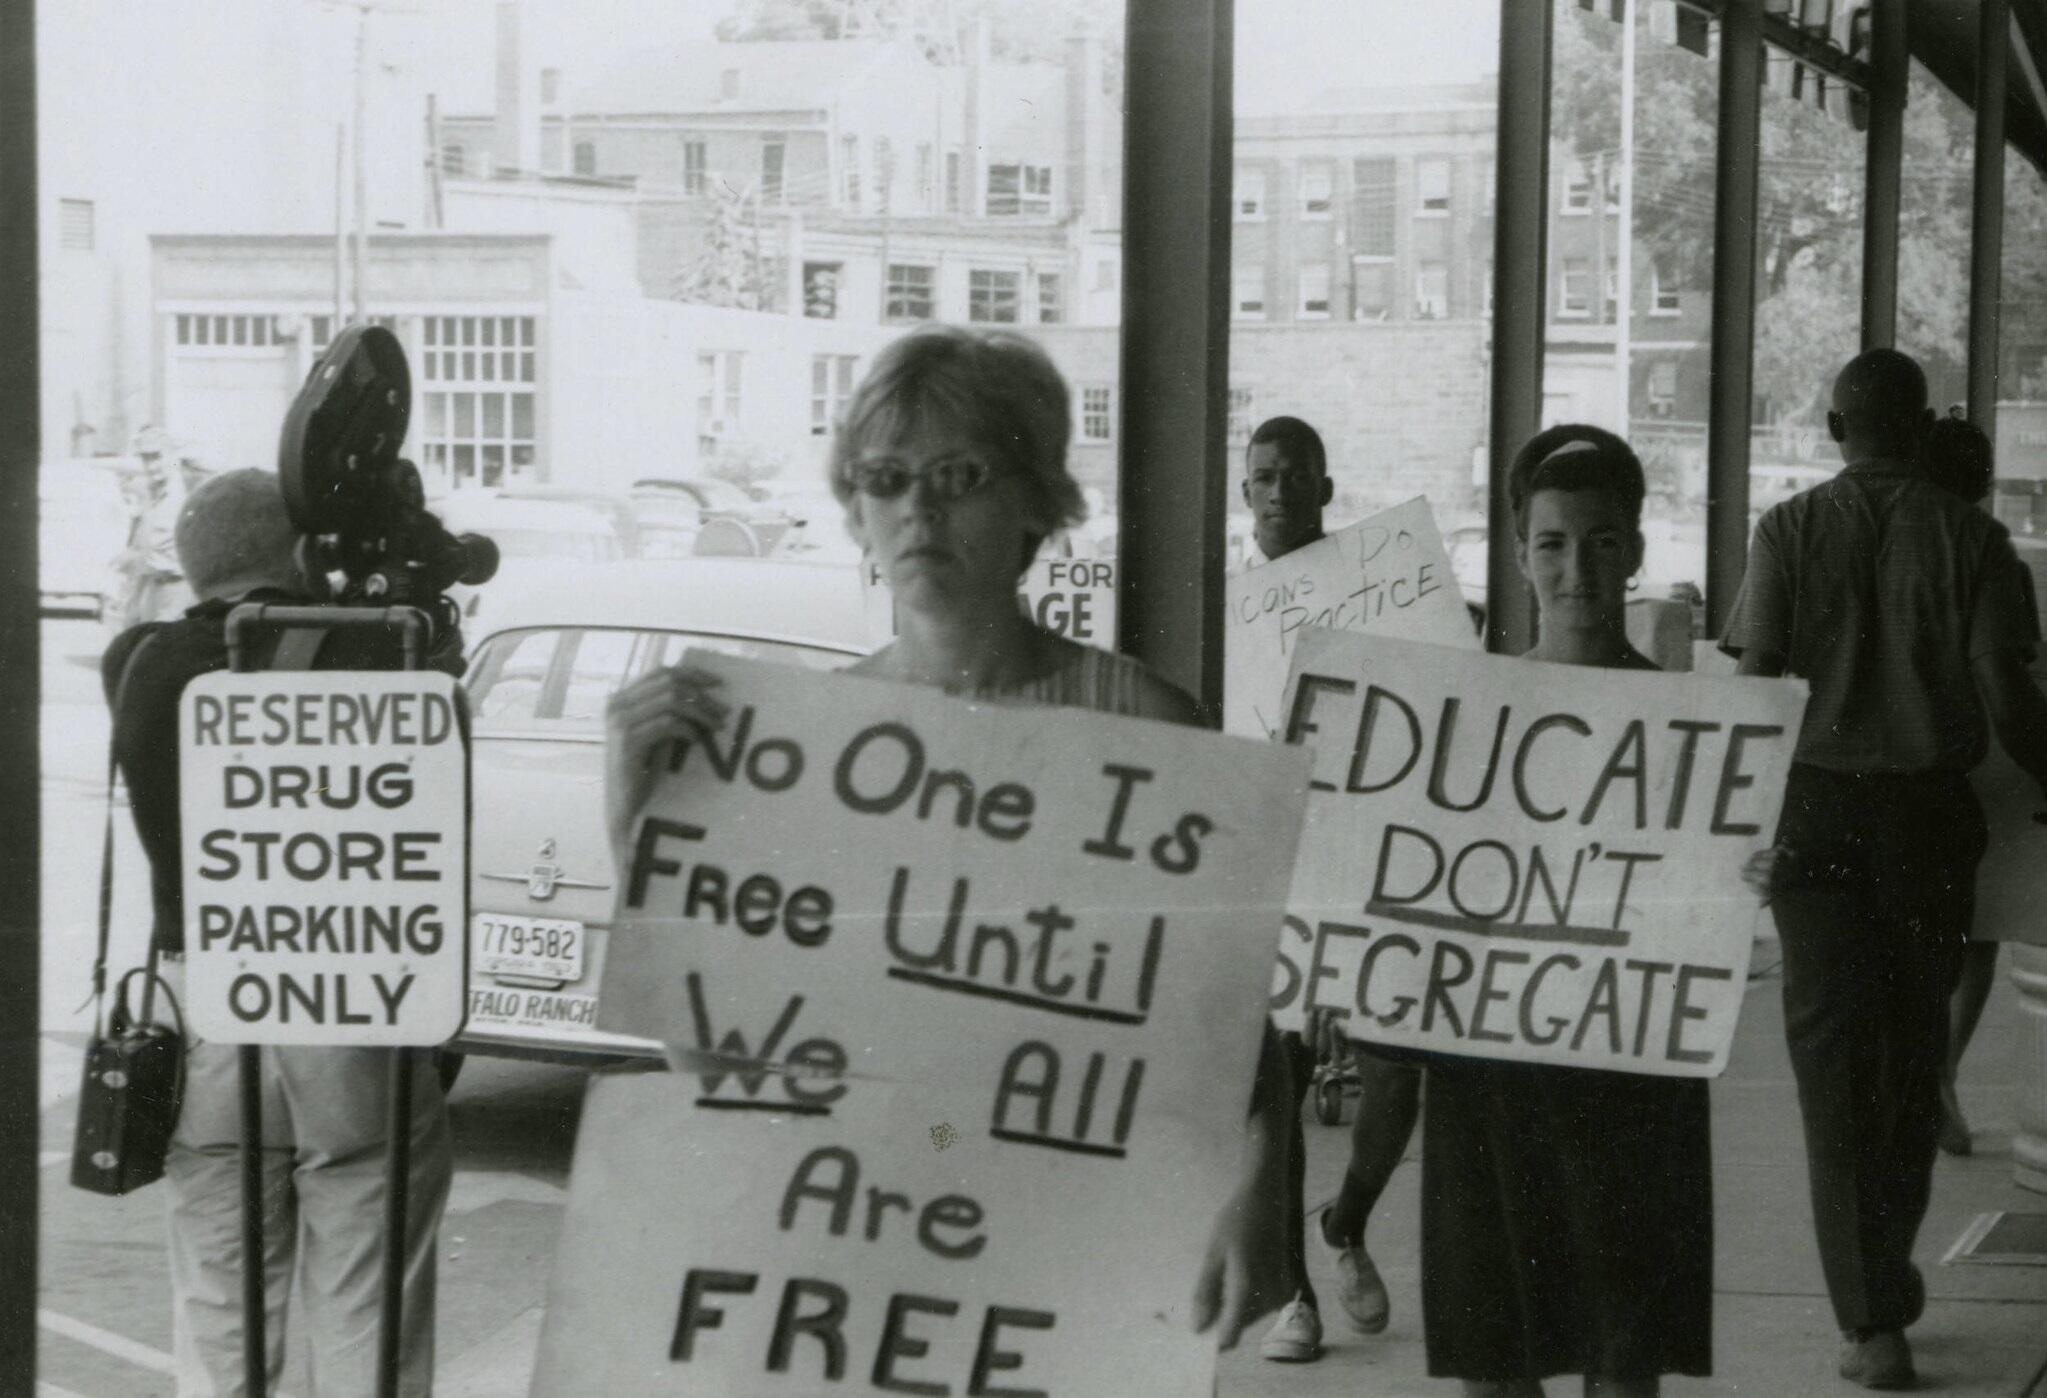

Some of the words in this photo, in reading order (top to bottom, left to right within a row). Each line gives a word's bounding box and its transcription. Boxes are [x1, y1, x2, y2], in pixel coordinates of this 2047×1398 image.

[1049, 563, 1113, 588] FOR
[194, 692, 452, 746] RESERVED
[1286, 673, 1784, 835] EDUCATE
[223, 763, 414, 808] DRUG
[644, 705, 803, 793] No
[835, 722, 1036, 841] One
[1083, 763, 1213, 875] Is
[198, 831, 441, 880] STORE
[1373, 824, 1663, 931] DON'T
[199, 904, 444, 955] PARKING
[482, 922, 575, 960] 779-582
[885, 866, 1164, 1011] Until
[227, 972, 416, 1025] ONLY
[470, 989, 520, 1017] FALO
[524, 995, 596, 1024] RANCH
[1269, 914, 1732, 1064] SEGREGATE
[687, 971, 848, 1102] We
[1000, 1041, 1145, 1145] All
[780, 1146, 988, 1260] Are
[669, 1268, 1056, 1398] FREE
